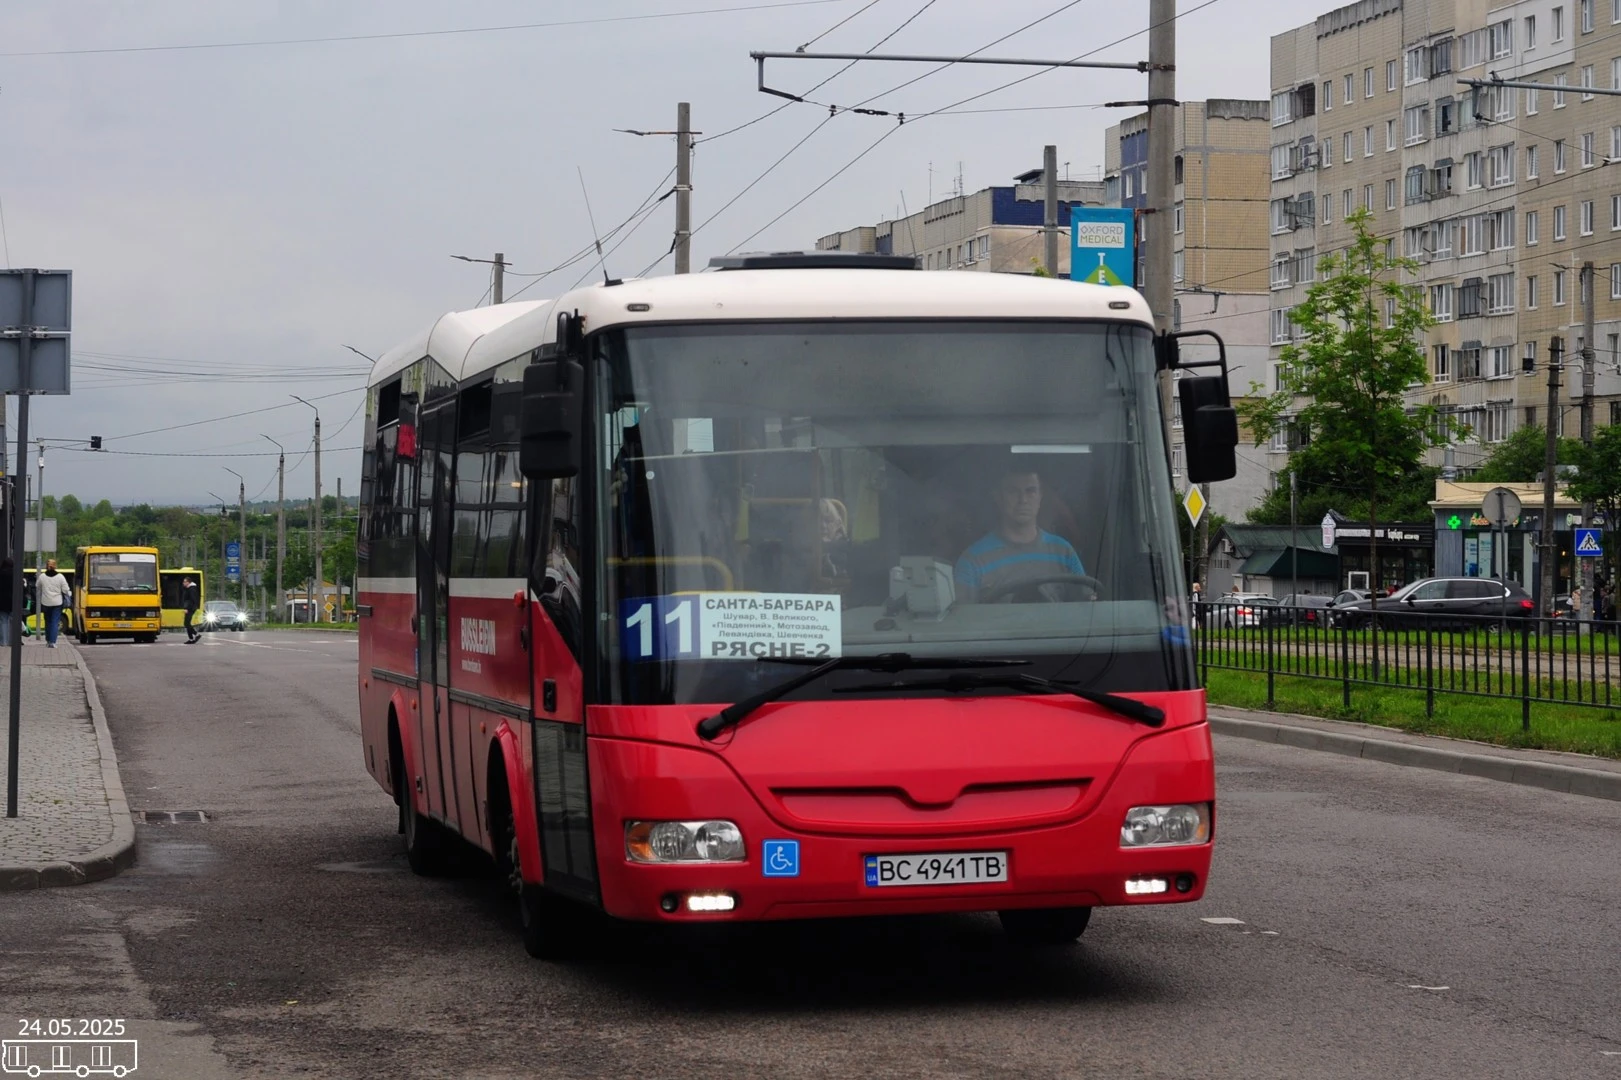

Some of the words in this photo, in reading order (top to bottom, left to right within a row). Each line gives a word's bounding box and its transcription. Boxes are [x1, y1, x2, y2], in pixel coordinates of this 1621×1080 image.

[1080, 225, 1123, 235] OXFORD
[1080, 235, 1122, 244] MEDICAL
[705, 598, 835, 612] САНТА-БАРБАРА
[723, 613, 758, 622] Шувар,
[772, 613, 819, 622] Великого,
[626, 600, 692, 657] 11
[777, 622, 830, 631] Мотозавод,
[718, 631, 775, 640] Левандівка,
[777, 631, 824, 640] Шевченка
[711, 641, 831, 659] РЯСНЕ-2
[917, 858, 965, 880] 4941
[867, 874, 877, 882] UA
